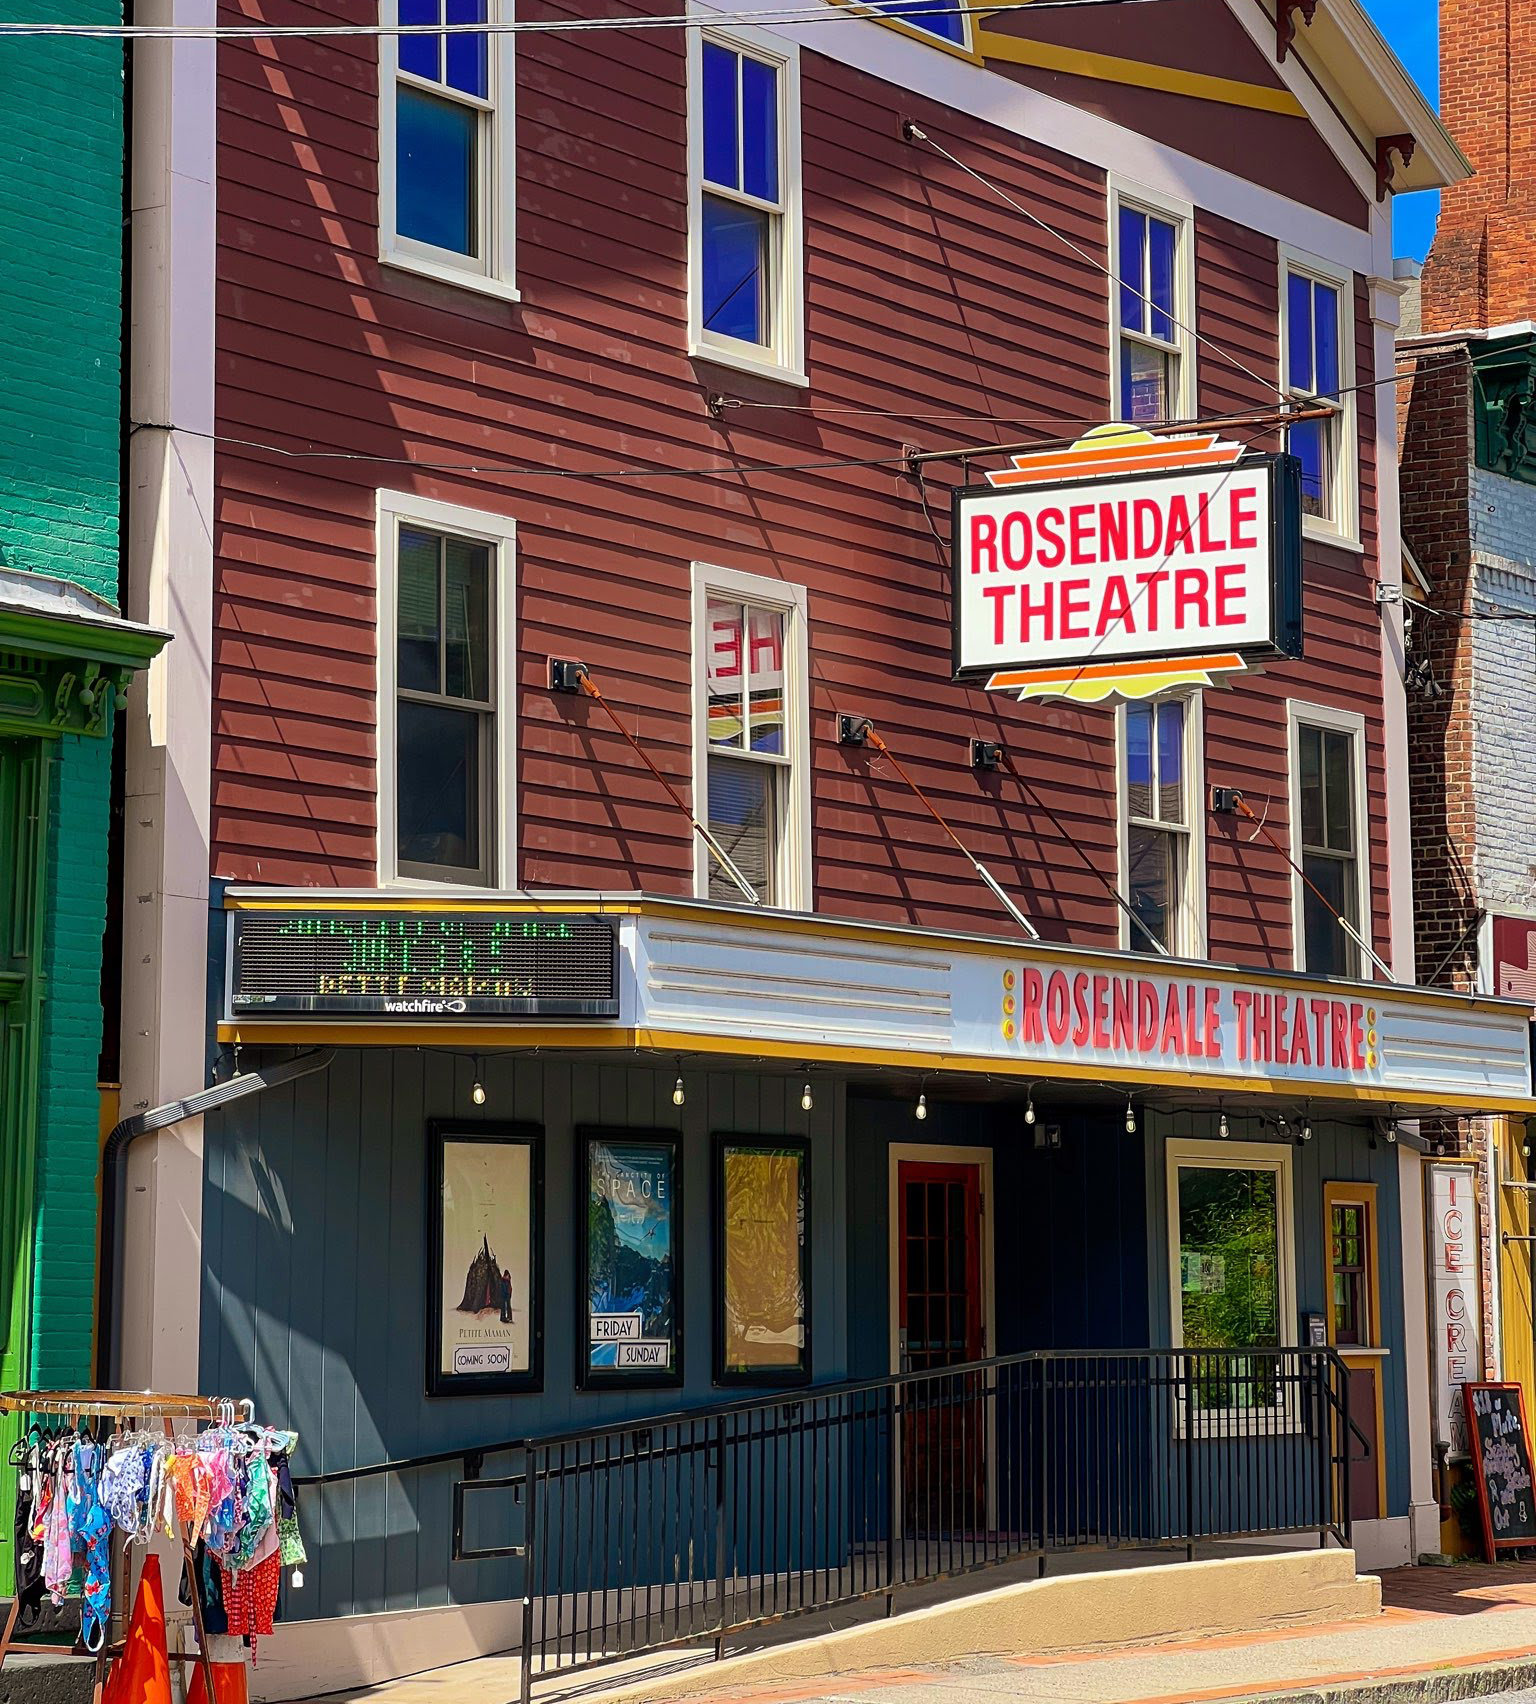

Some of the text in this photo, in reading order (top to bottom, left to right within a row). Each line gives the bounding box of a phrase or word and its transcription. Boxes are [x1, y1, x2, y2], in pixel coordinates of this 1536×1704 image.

[970, 487, 1258, 574] ROSENDALE
[983, 564, 1247, 645] THEATRE
[384, 999, 444, 1013] watchfire
[1022, 967, 1366, 1070] ROSENDALE THEATRE
[596, 1178, 666, 1199] SPACE
[1443, 1176, 1464, 1273] ICE
[596, 1320, 633, 1337] FRIDAY
[457, 1353, 508, 1366] COMING SOON
[626, 1347, 661, 1363] SUNDAY
